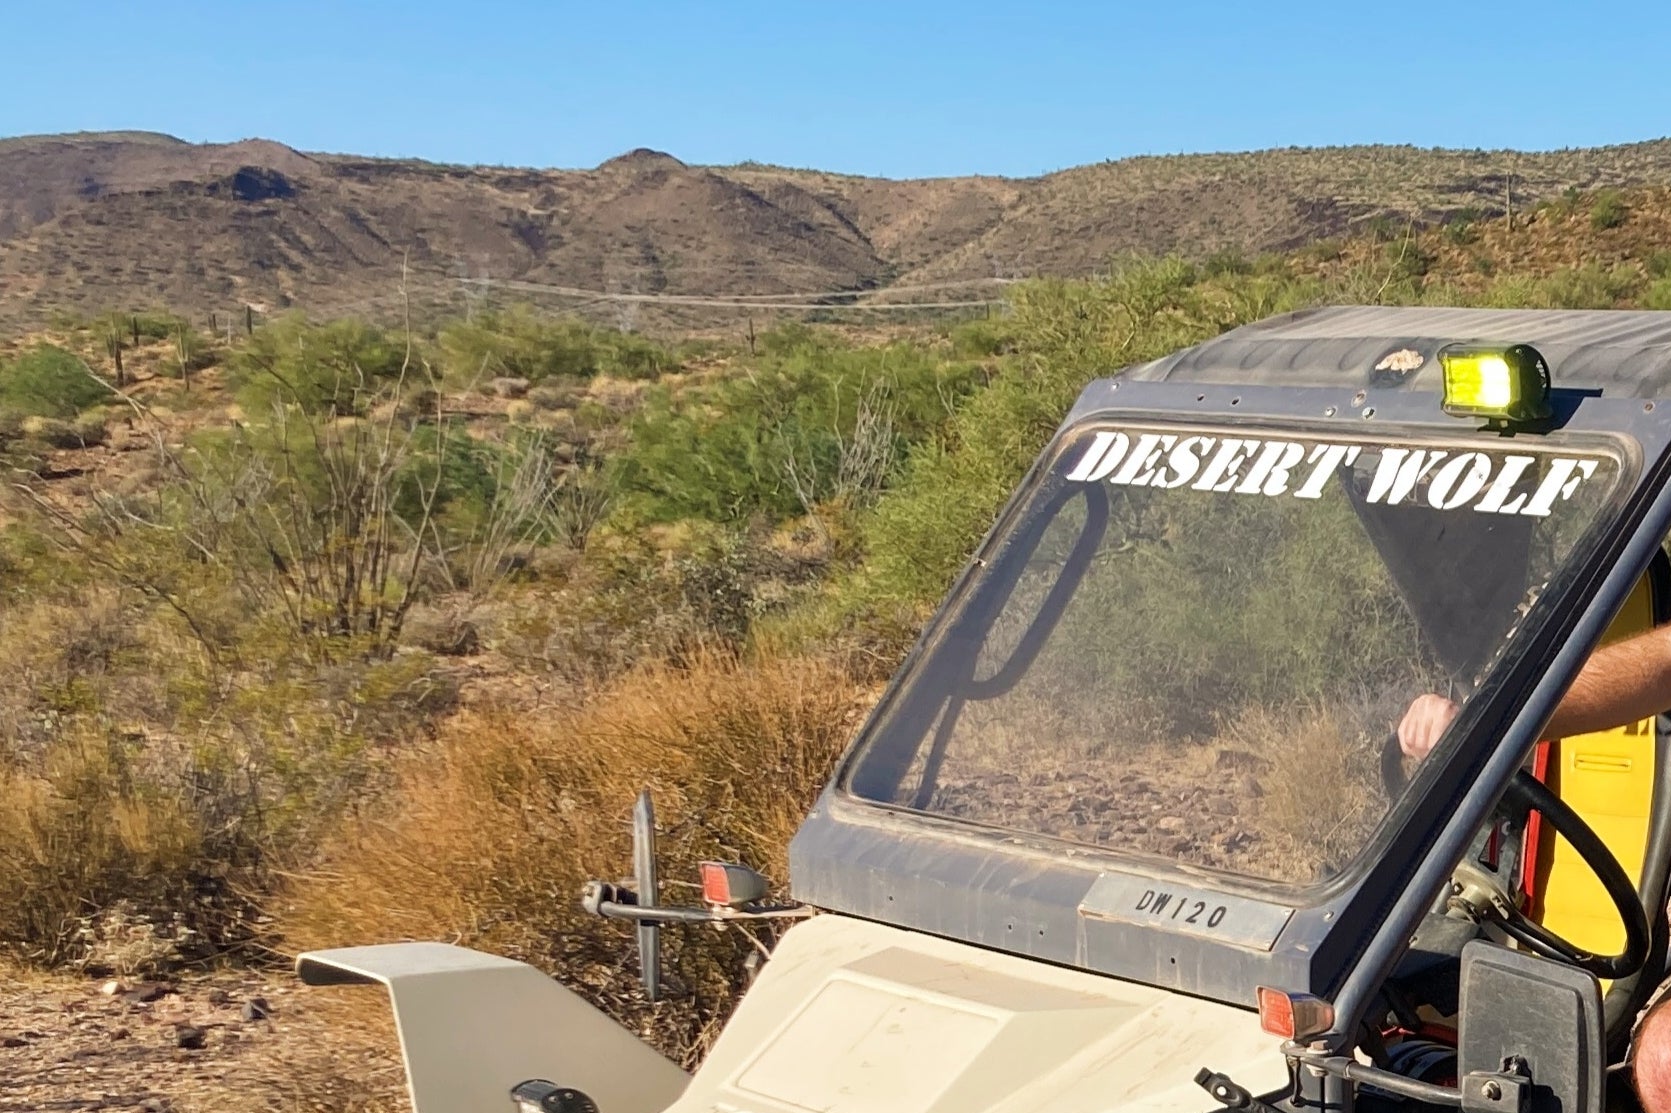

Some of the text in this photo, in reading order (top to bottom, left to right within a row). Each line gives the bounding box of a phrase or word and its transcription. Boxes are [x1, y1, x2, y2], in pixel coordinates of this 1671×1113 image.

[1066, 432, 1598, 516] DESERT WOLF
[1135, 889, 1228, 928] DW120
